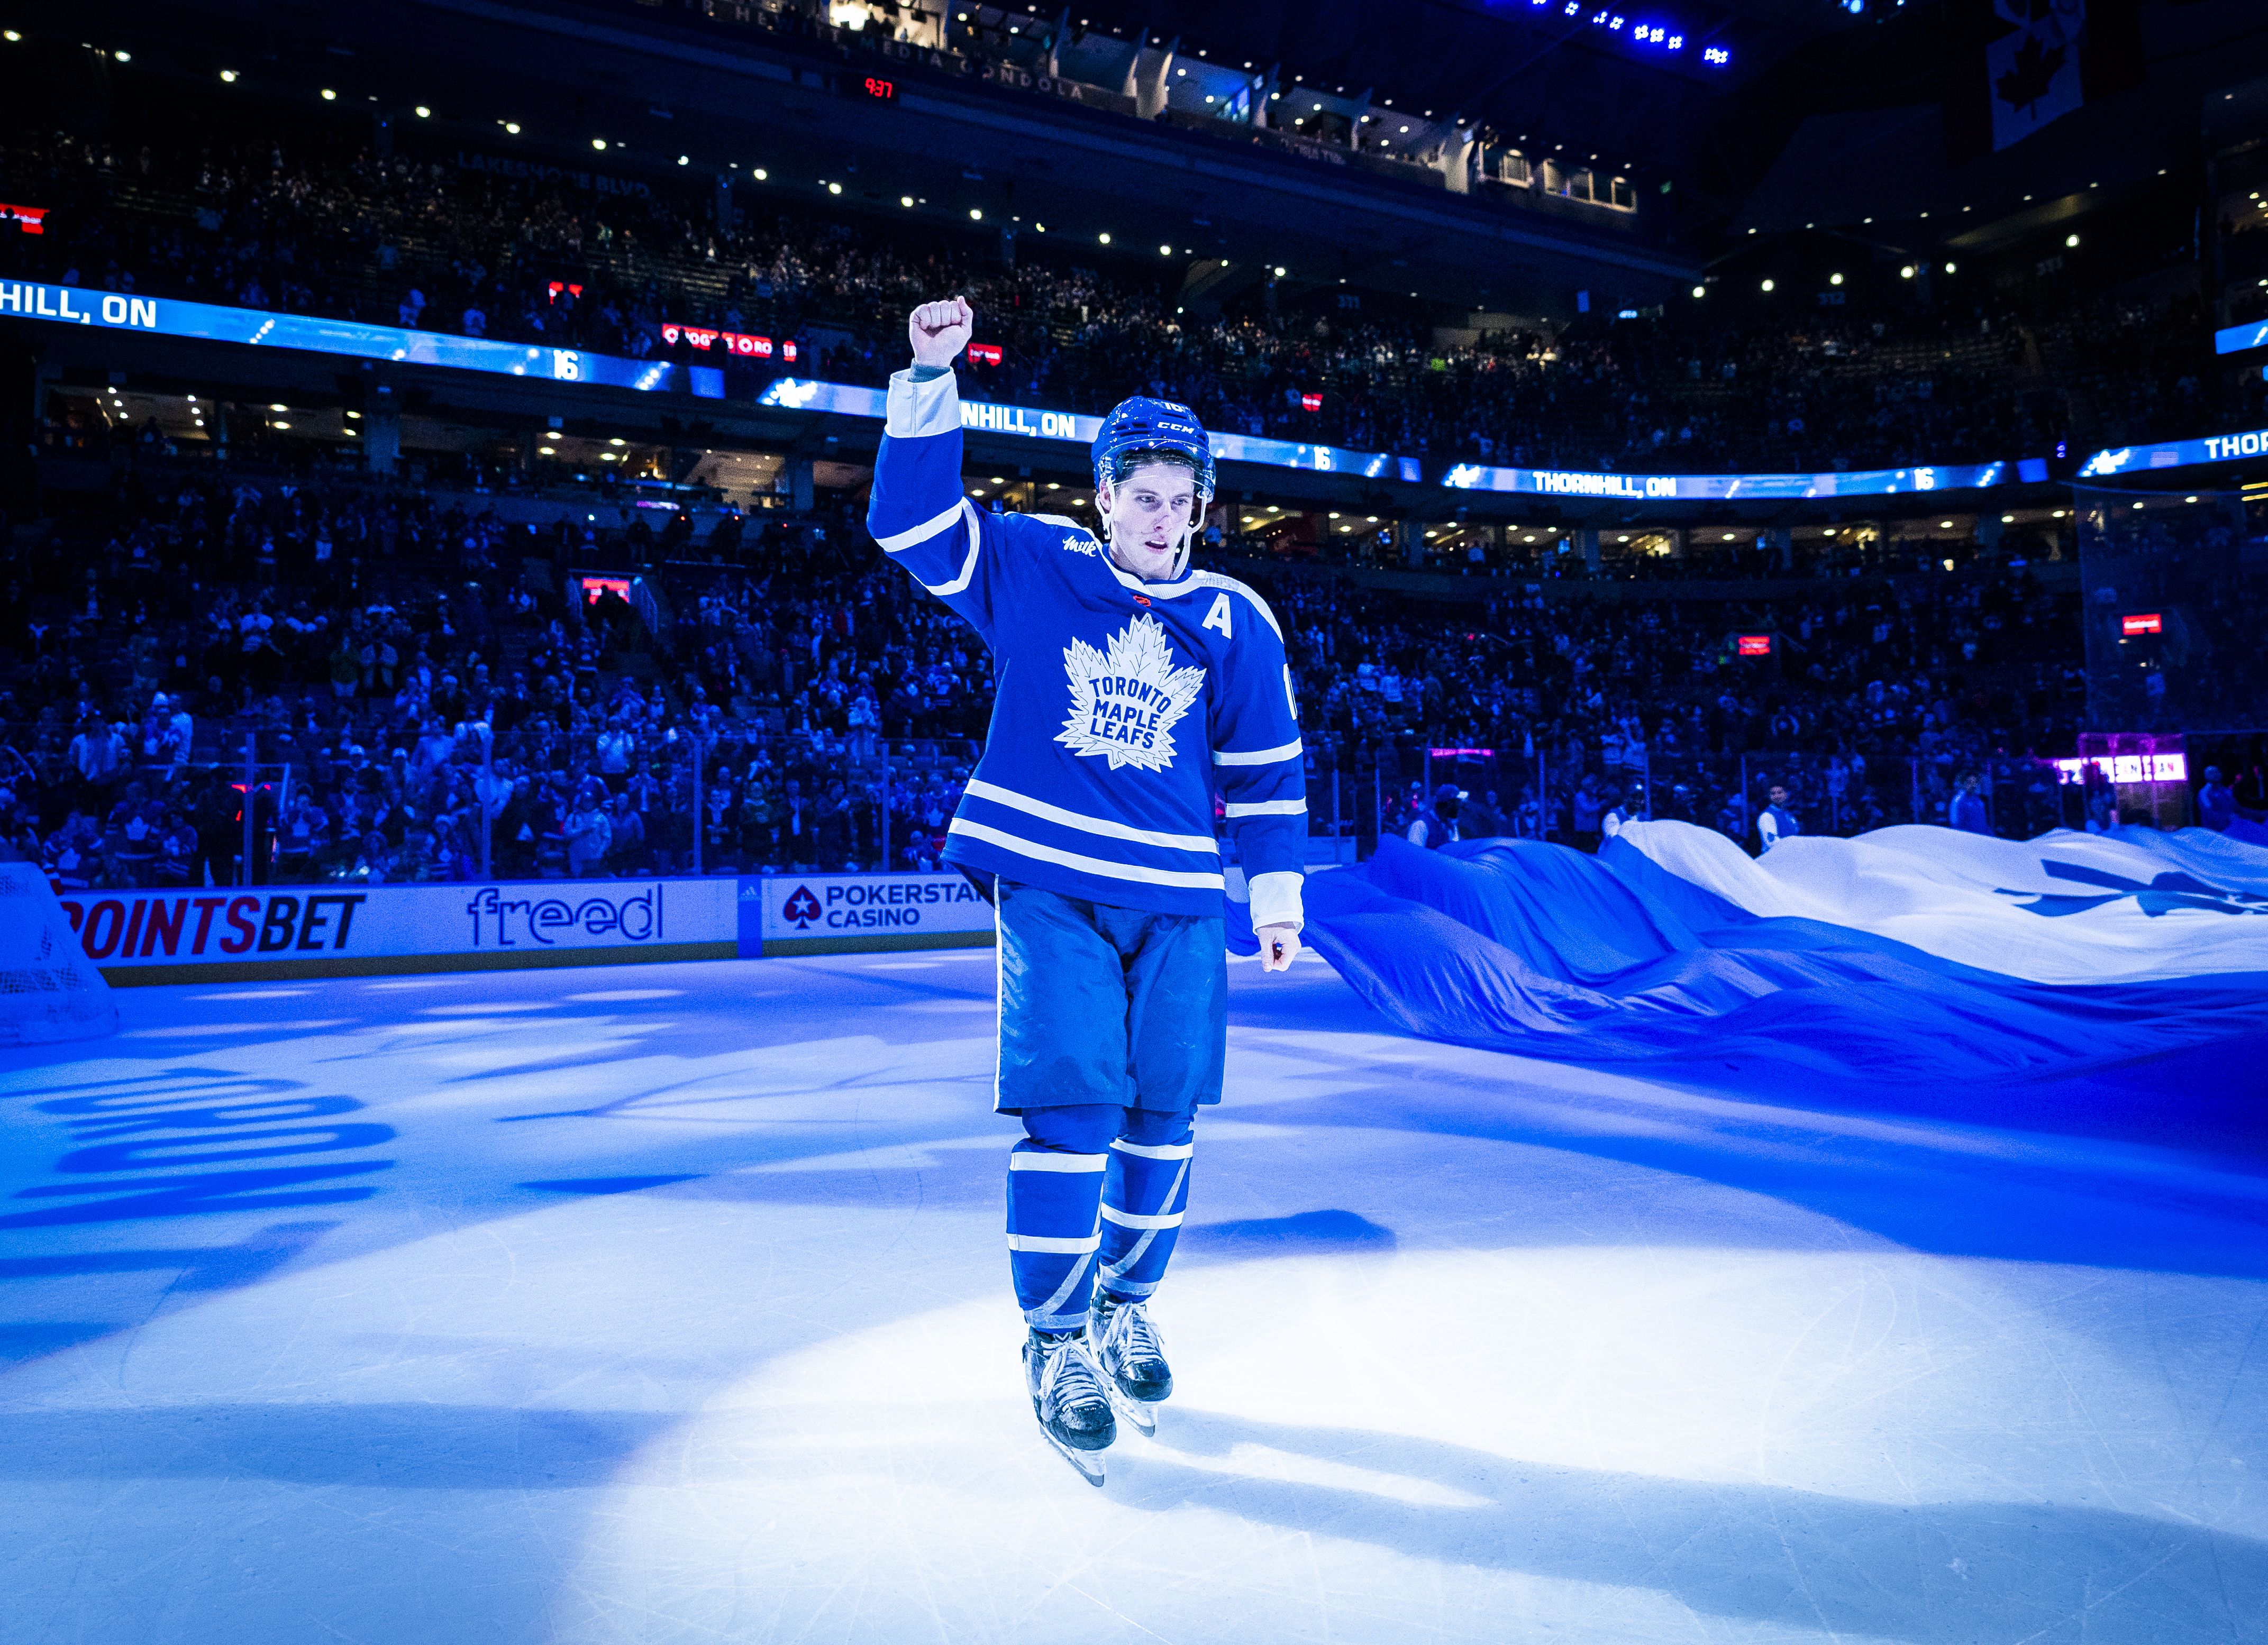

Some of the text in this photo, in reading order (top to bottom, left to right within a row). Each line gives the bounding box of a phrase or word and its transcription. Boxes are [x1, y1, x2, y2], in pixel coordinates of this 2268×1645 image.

[103, 295, 156, 328] ON
[553, 349, 578, 380] 16
[959, 402, 1075, 438] NHILL, ON
[1158, 422, 1194, 434] CCM
[1314, 446, 1331, 470] 16
[1532, 471, 1677, 499] THORNHILL, ON
[1914, 468, 1934, 491] 16
[1201, 592, 1232, 639] A
[1089, 676, 1172, 714] TORONTO
[1092, 698, 1161, 732] MAPLE
[1089, 717, 1155, 750] LEAFS
[467, 883, 663, 946] freed
[826, 907, 921, 929] CASINO
